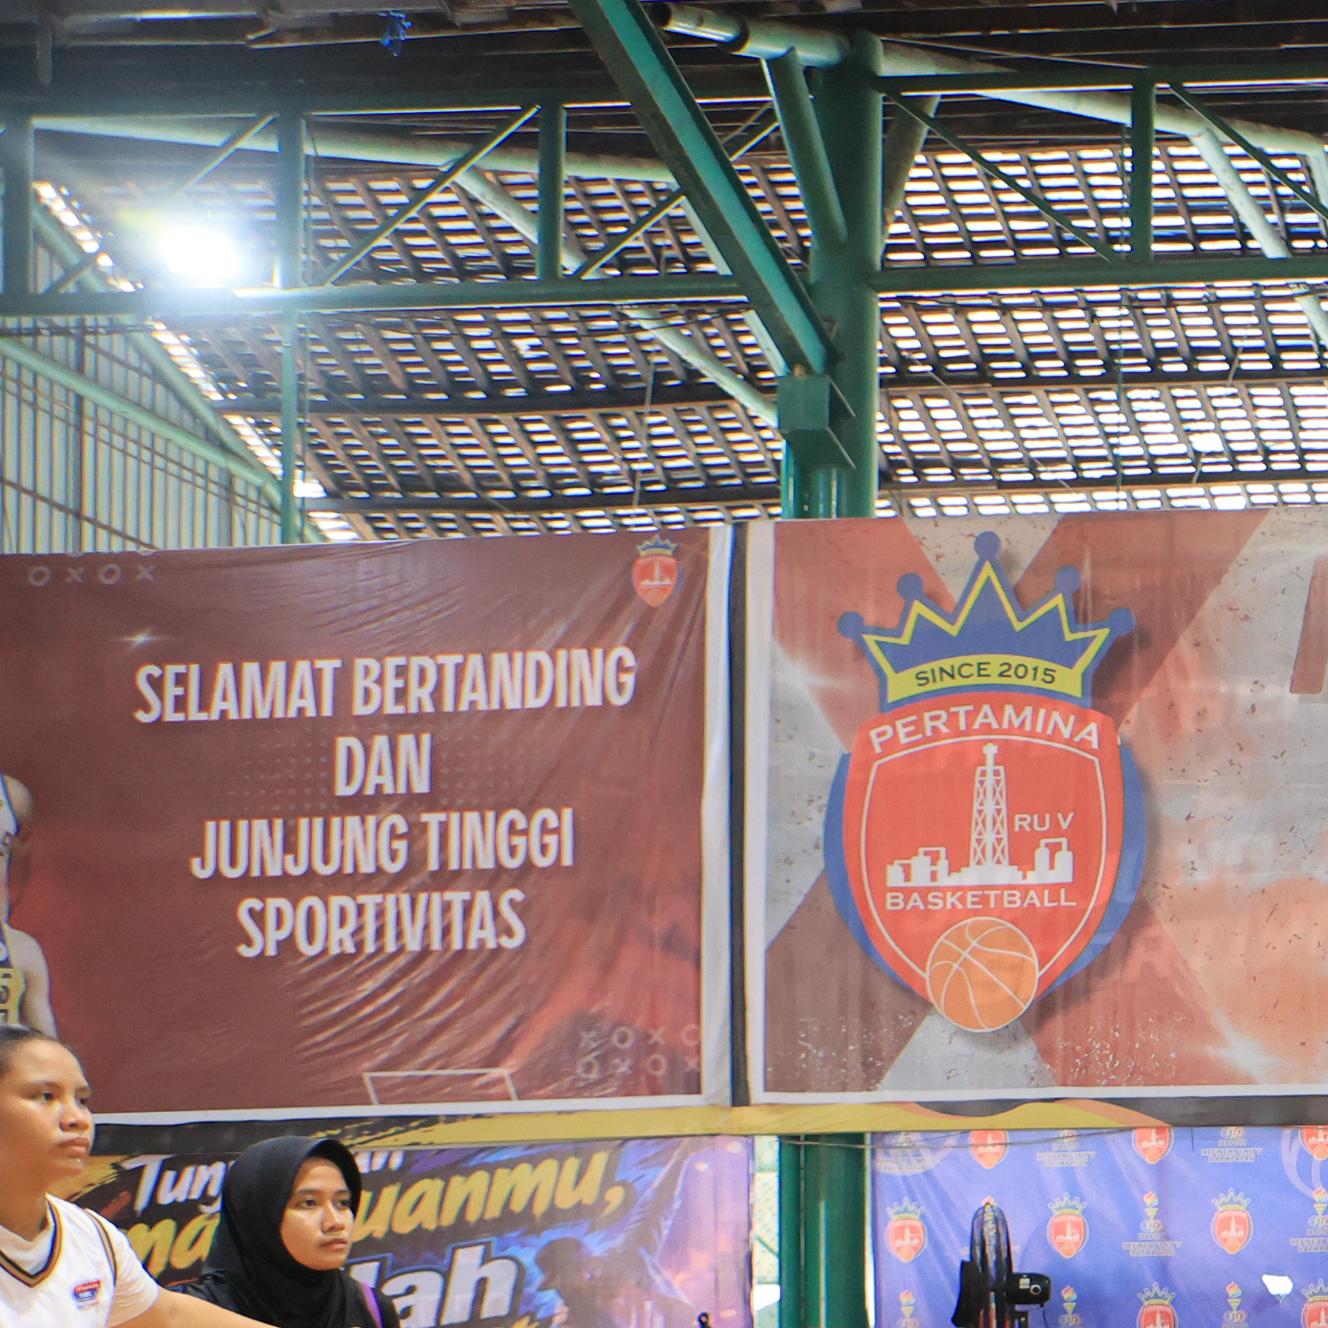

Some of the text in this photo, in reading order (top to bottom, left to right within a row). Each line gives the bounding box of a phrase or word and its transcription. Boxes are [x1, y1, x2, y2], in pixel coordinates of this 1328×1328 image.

[134, 646, 637, 724] SELAMAT BERTANDING
[915, 661, 1057, 688] SINCE 2015
[868, 703, 1101, 754] PERTAMINA
[333, 733, 432, 797] DAN
[191, 807, 575, 879] JUNJUNG TINGGI
[1014, 812, 1075, 832] RU V
[236, 889, 526, 958] SPORTIVITAS
[886, 886, 1077, 911] BASKETBALL
